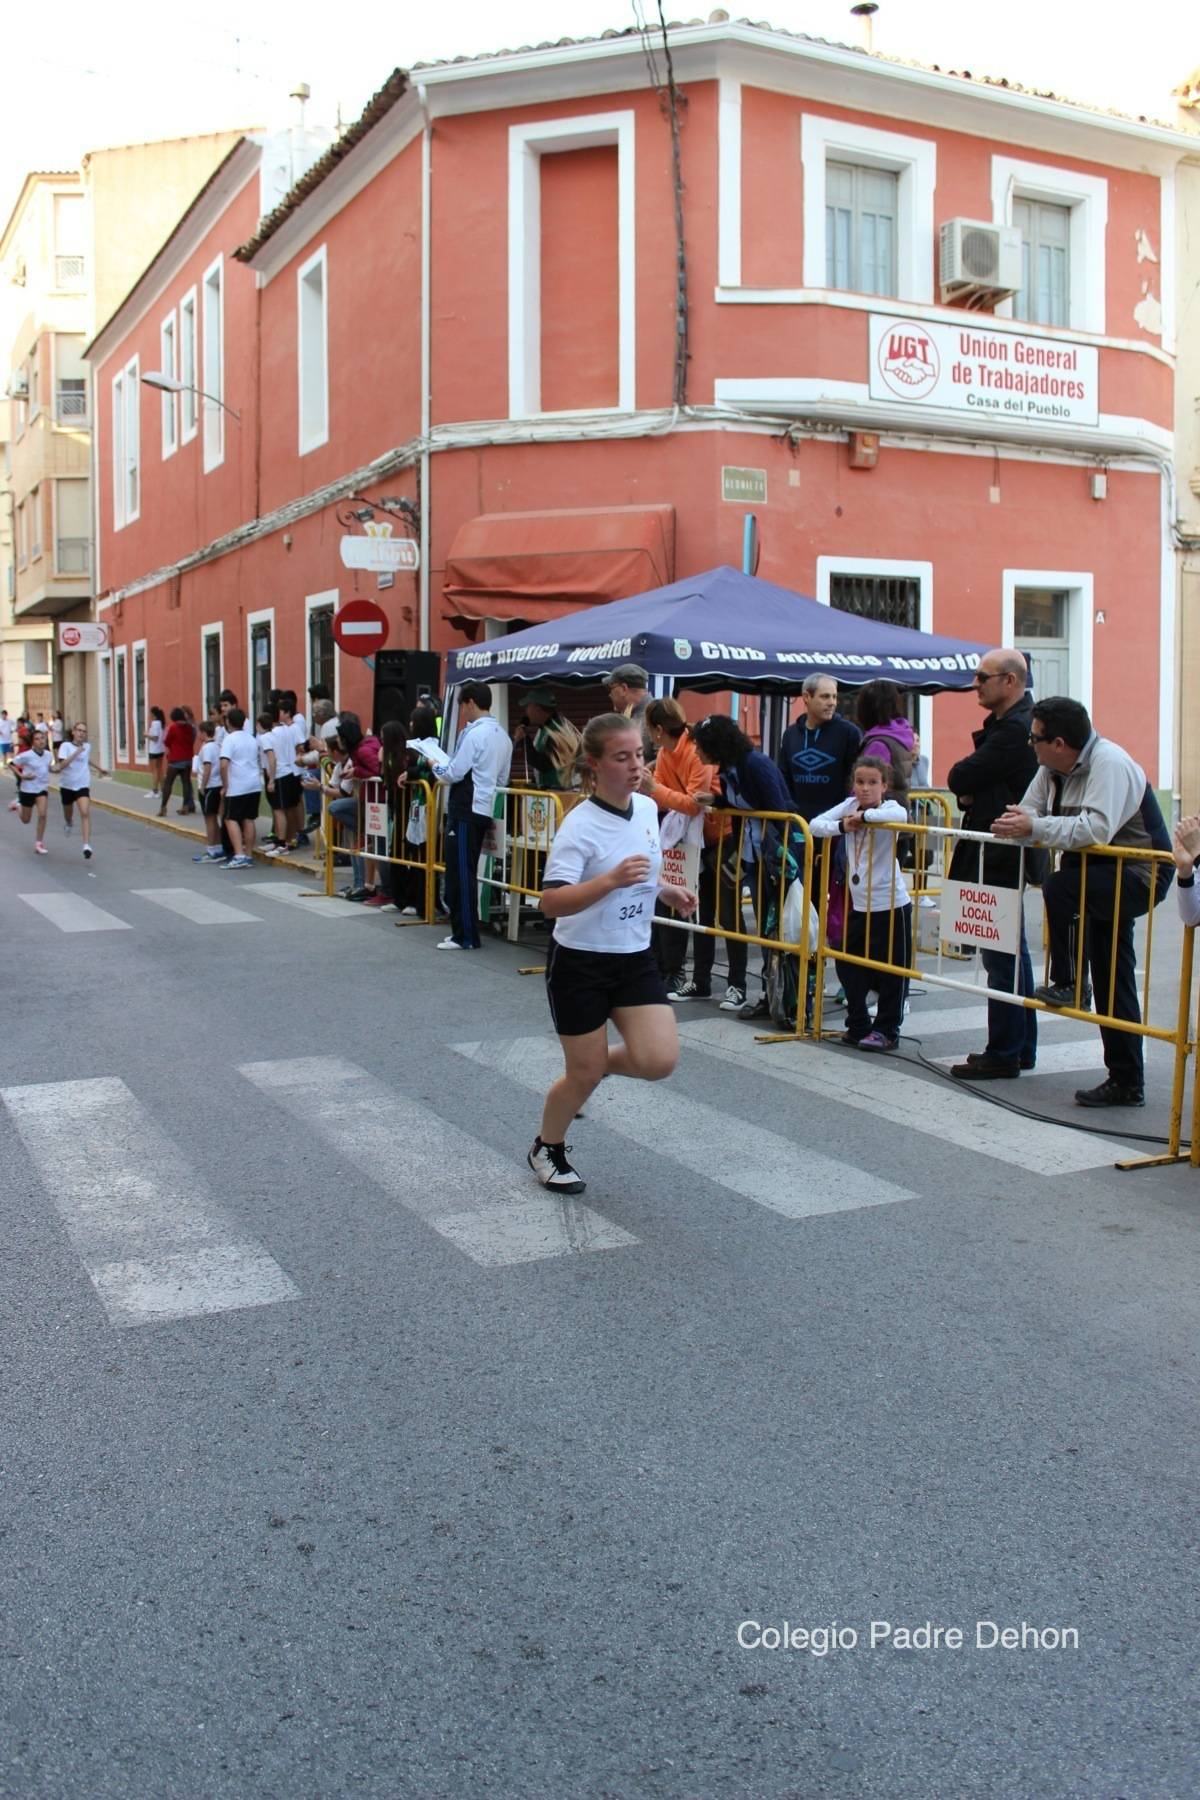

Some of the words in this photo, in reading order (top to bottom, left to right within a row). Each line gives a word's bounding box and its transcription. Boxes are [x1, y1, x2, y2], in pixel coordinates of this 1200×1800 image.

[888, 334, 929, 364] UGT
[960, 333, 1008, 361] Unión
[1014, 341, 1077, 370] General
[952, 362, 973, 384] de
[978, 364, 1084, 399] Trabajadores
[966, 393, 999, 409] Casa
[1004, 397, 1024, 412] del
[1028, 402, 1071, 417] Pueblo
[700, 641, 766, 661] Club
[887, 653, 982, 671] Noveld
[663, 861, 684, 874] LOCAL
[959, 888, 997, 906] POLICIA
[618, 902, 643, 921] 324
[962, 906, 994, 923] LOCAL
[954, 921, 1000, 941] NOVELDA
